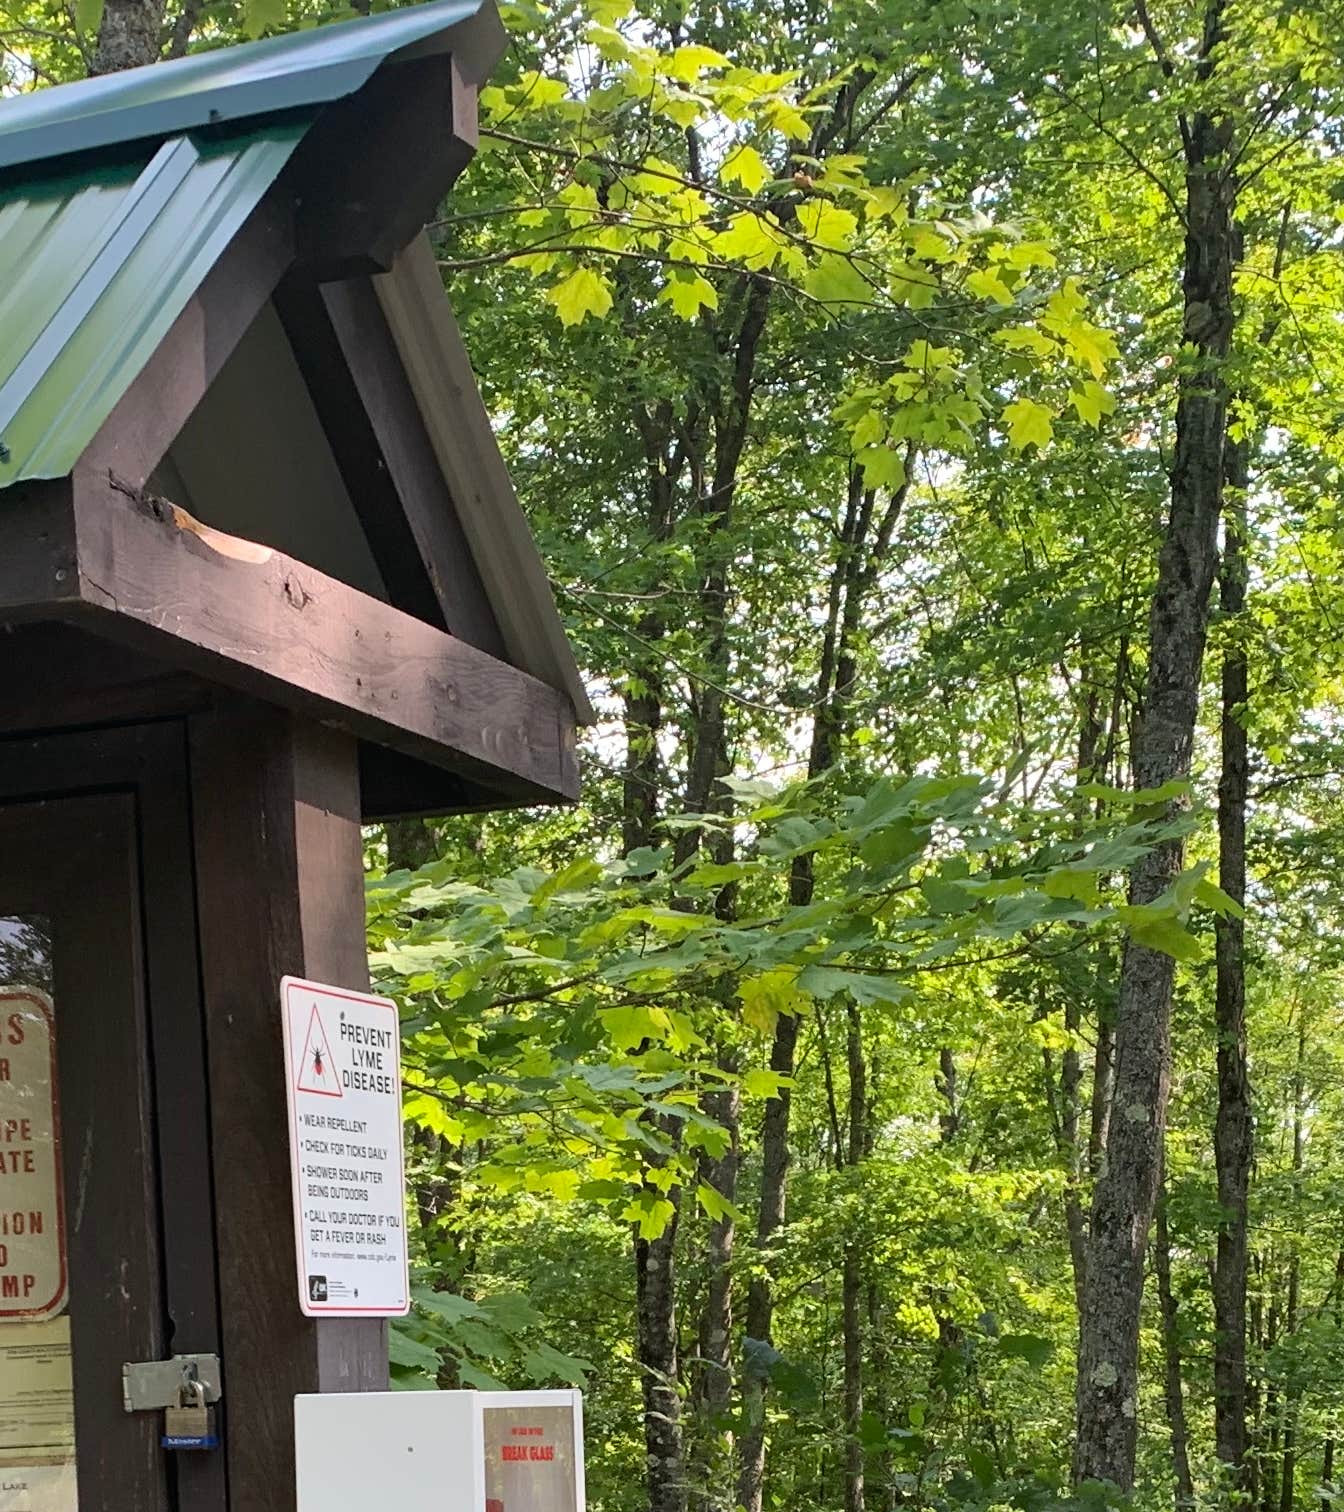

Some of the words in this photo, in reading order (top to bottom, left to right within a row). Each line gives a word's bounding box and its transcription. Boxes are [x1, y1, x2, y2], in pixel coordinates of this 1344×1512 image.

[340, 1023, 392, 1048] PREVENT
[352, 1048, 383, 1070] LYME
[343, 1070, 395, 1094] DISEASE!
[304, 1114, 326, 1128] WEAR
[327, 1117, 367, 1133] REPELLENT
[305, 1140, 328, 1153] CHECK
[331, 1142, 344, 1155] FOR
[346, 1144, 366, 1158] TICKS
[368, 1147, 388, 1160] DAILY
[306, 1165, 337, 1180] SHOWER
[339, 1168, 358, 1181] SOON
[360, 1171, 383, 1184] AFTER
[308, 1184, 329, 1198] BEING
[330, 1186, 368, 1201] OUTDOORS
[309, 1210, 327, 1223] CALL
[328, 1212, 347, 1224] YOUR
[348, 1213, 376, 1226] DOCTOR
[378, 1215, 384, 1226] IF
[386, 1216, 400, 1228] YOU
[310, 1229, 324, 1242] GET
[326, 1230, 330, 1241] A
[332, 1230, 354, 1243] FEVER
[356, 1232, 365, 1244] OR
[366, 1233, 386, 1246] RASH
[502, 1445, 528, 1461] BREAK
[530, 1445, 554, 1461] GLASS
